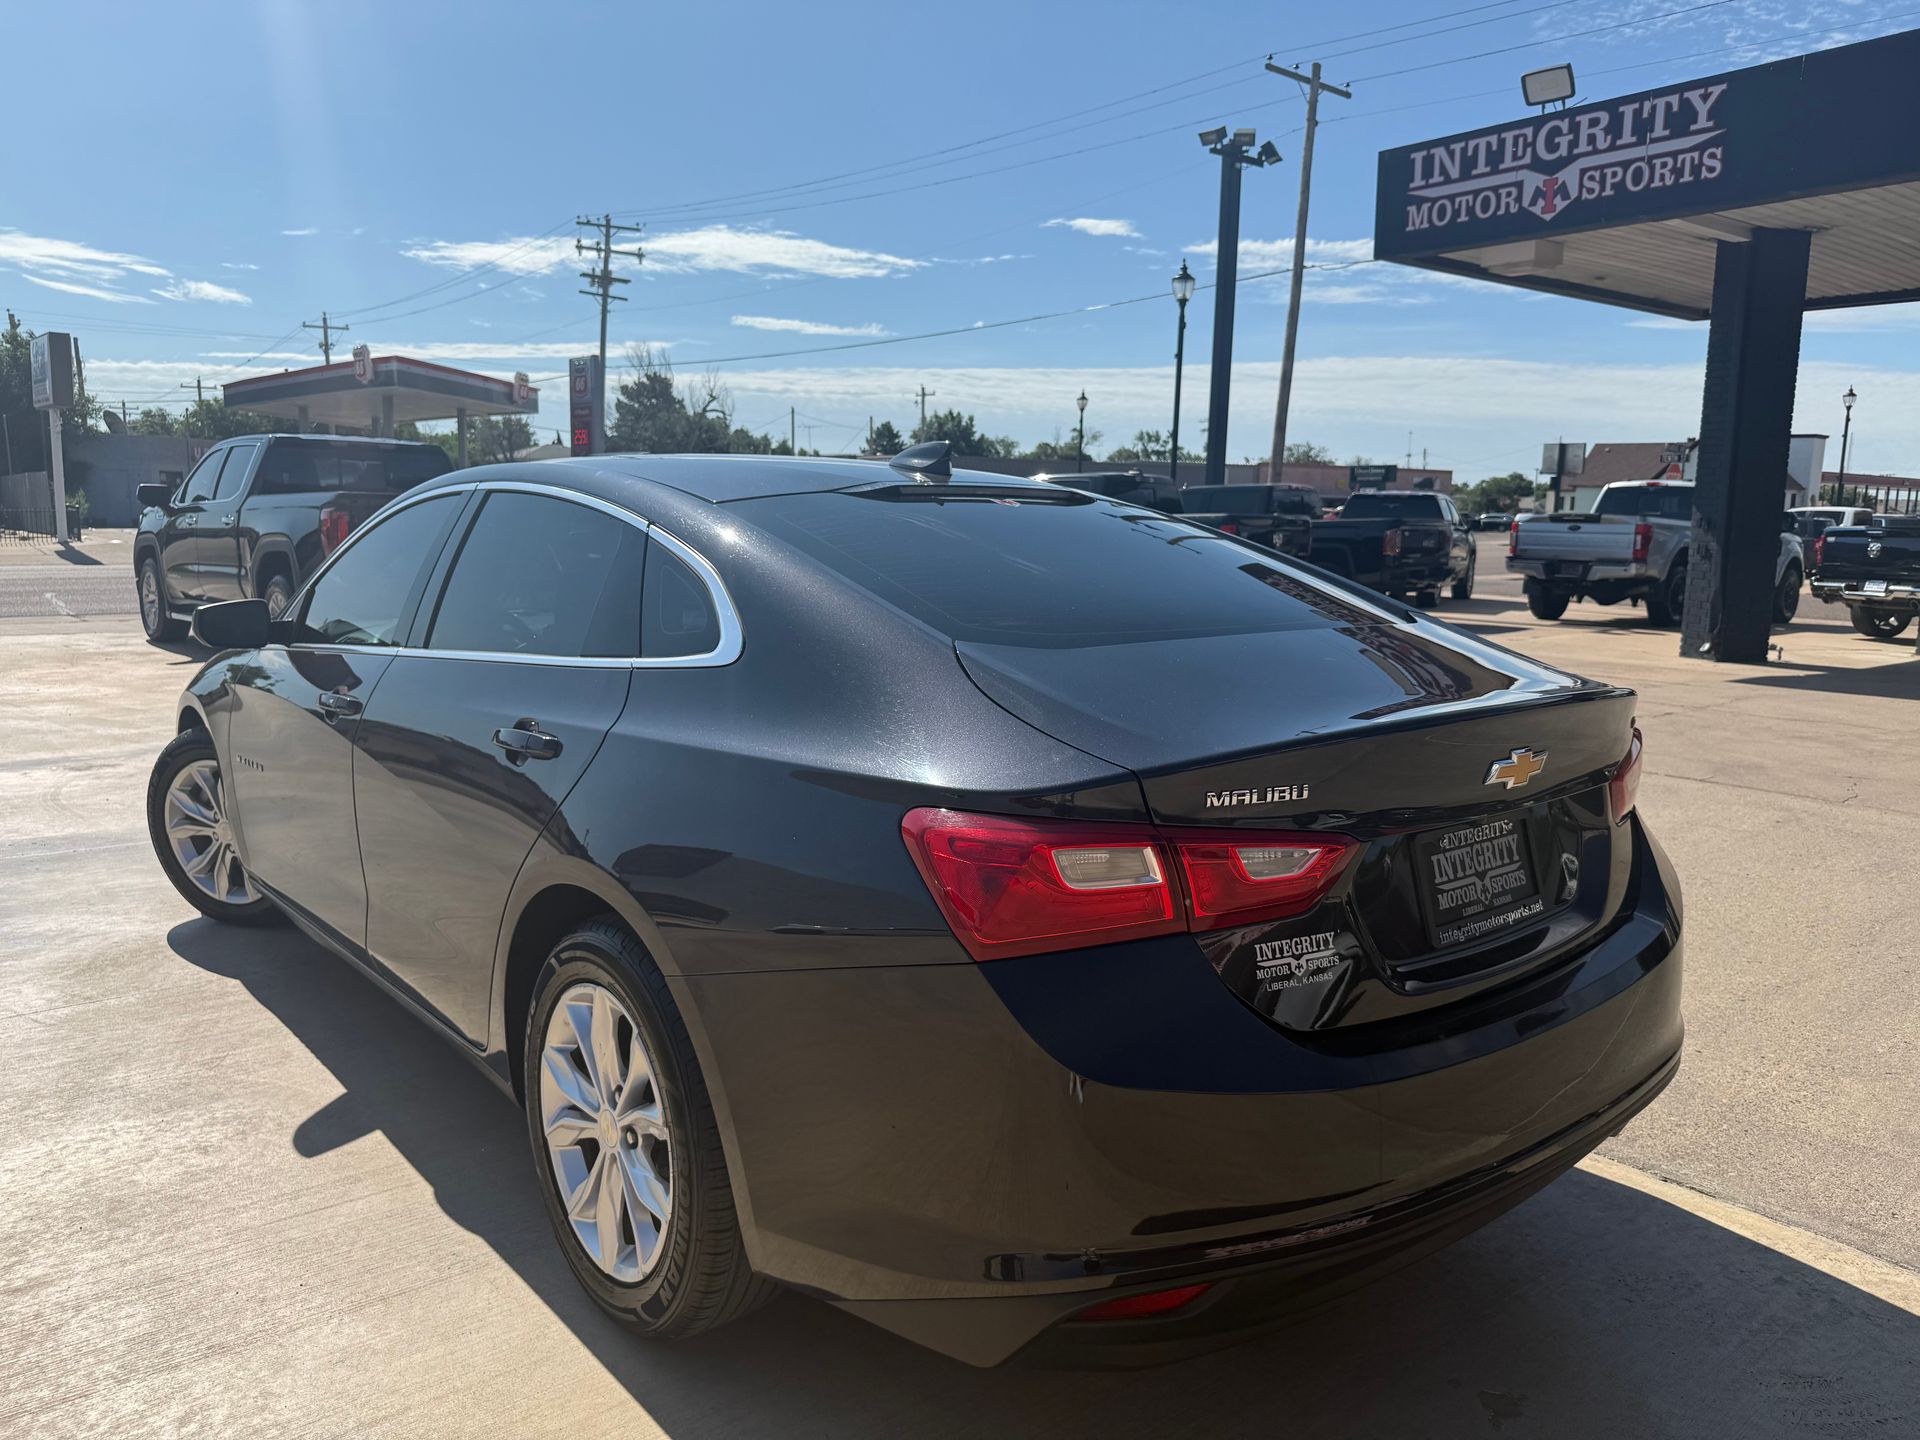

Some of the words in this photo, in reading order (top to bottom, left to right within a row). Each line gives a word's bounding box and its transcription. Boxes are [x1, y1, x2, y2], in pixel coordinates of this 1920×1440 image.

[1409, 83, 1728, 189] INTEGRITY
[1405, 186, 1519, 232] MOTOR
[1582, 147, 1723, 201] SPORTS
[1206, 784, 1309, 808] MALIBU
[1443, 820, 1511, 848] INTEGRITY
[1431, 834, 1520, 883] INTEGRITY
[1437, 885, 1478, 910] MOTOR
[1492, 870, 1526, 893] SPORTS
[1440, 899, 1543, 944] integritymotorsports.net
[1254, 931, 1335, 961] INTEGRITY
[1256, 965, 1290, 980] MOTOR
[1308, 956, 1340, 970] SPORTS
[1266, 979, 1302, 992] LIBERAL,
[1303, 972, 1334, 985] KANSAS
